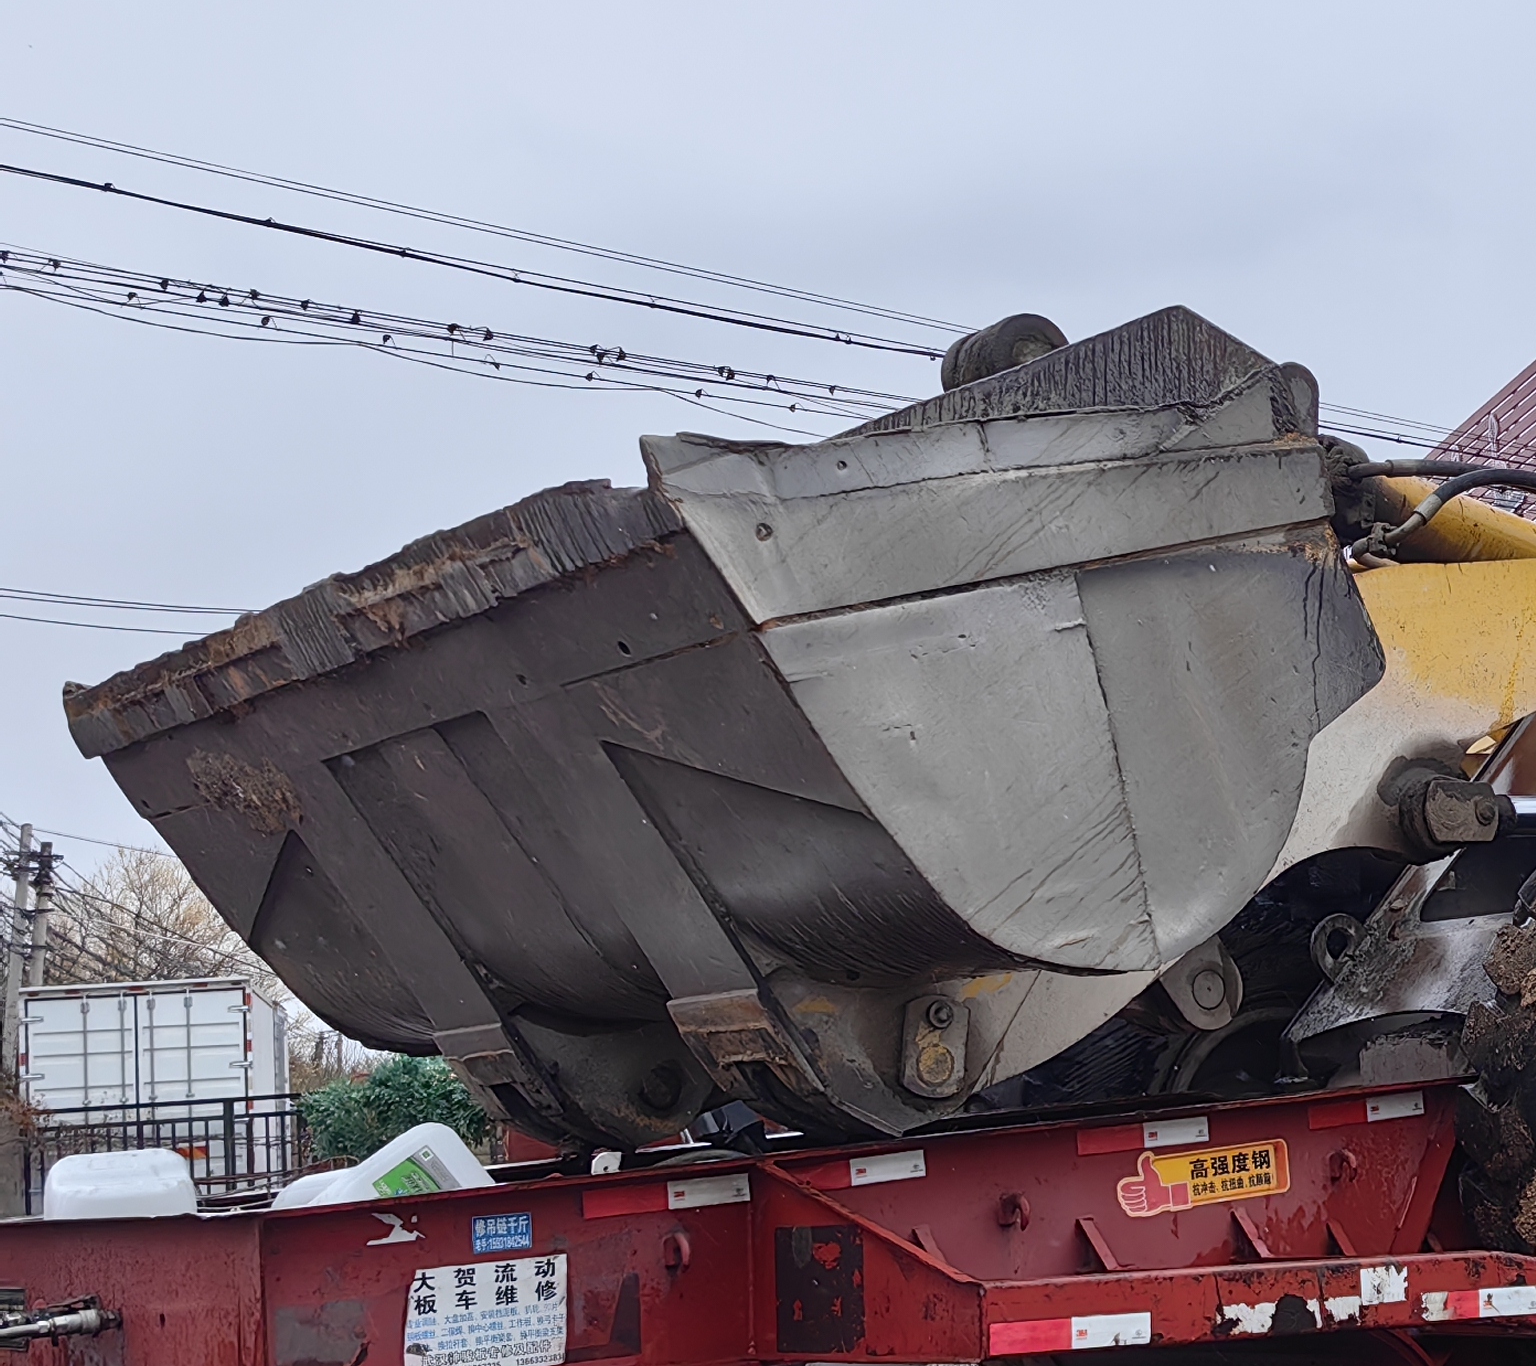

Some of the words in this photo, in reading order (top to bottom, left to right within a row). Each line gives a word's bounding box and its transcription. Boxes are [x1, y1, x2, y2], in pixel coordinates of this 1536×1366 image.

[1189, 1149, 1271, 1180] 高强度钢
[474, 1215, 529, 1237] 修吊链千斤
[413, 1258, 556, 1293] 大贺流动
[413, 1280, 558, 1316] 板车维修
